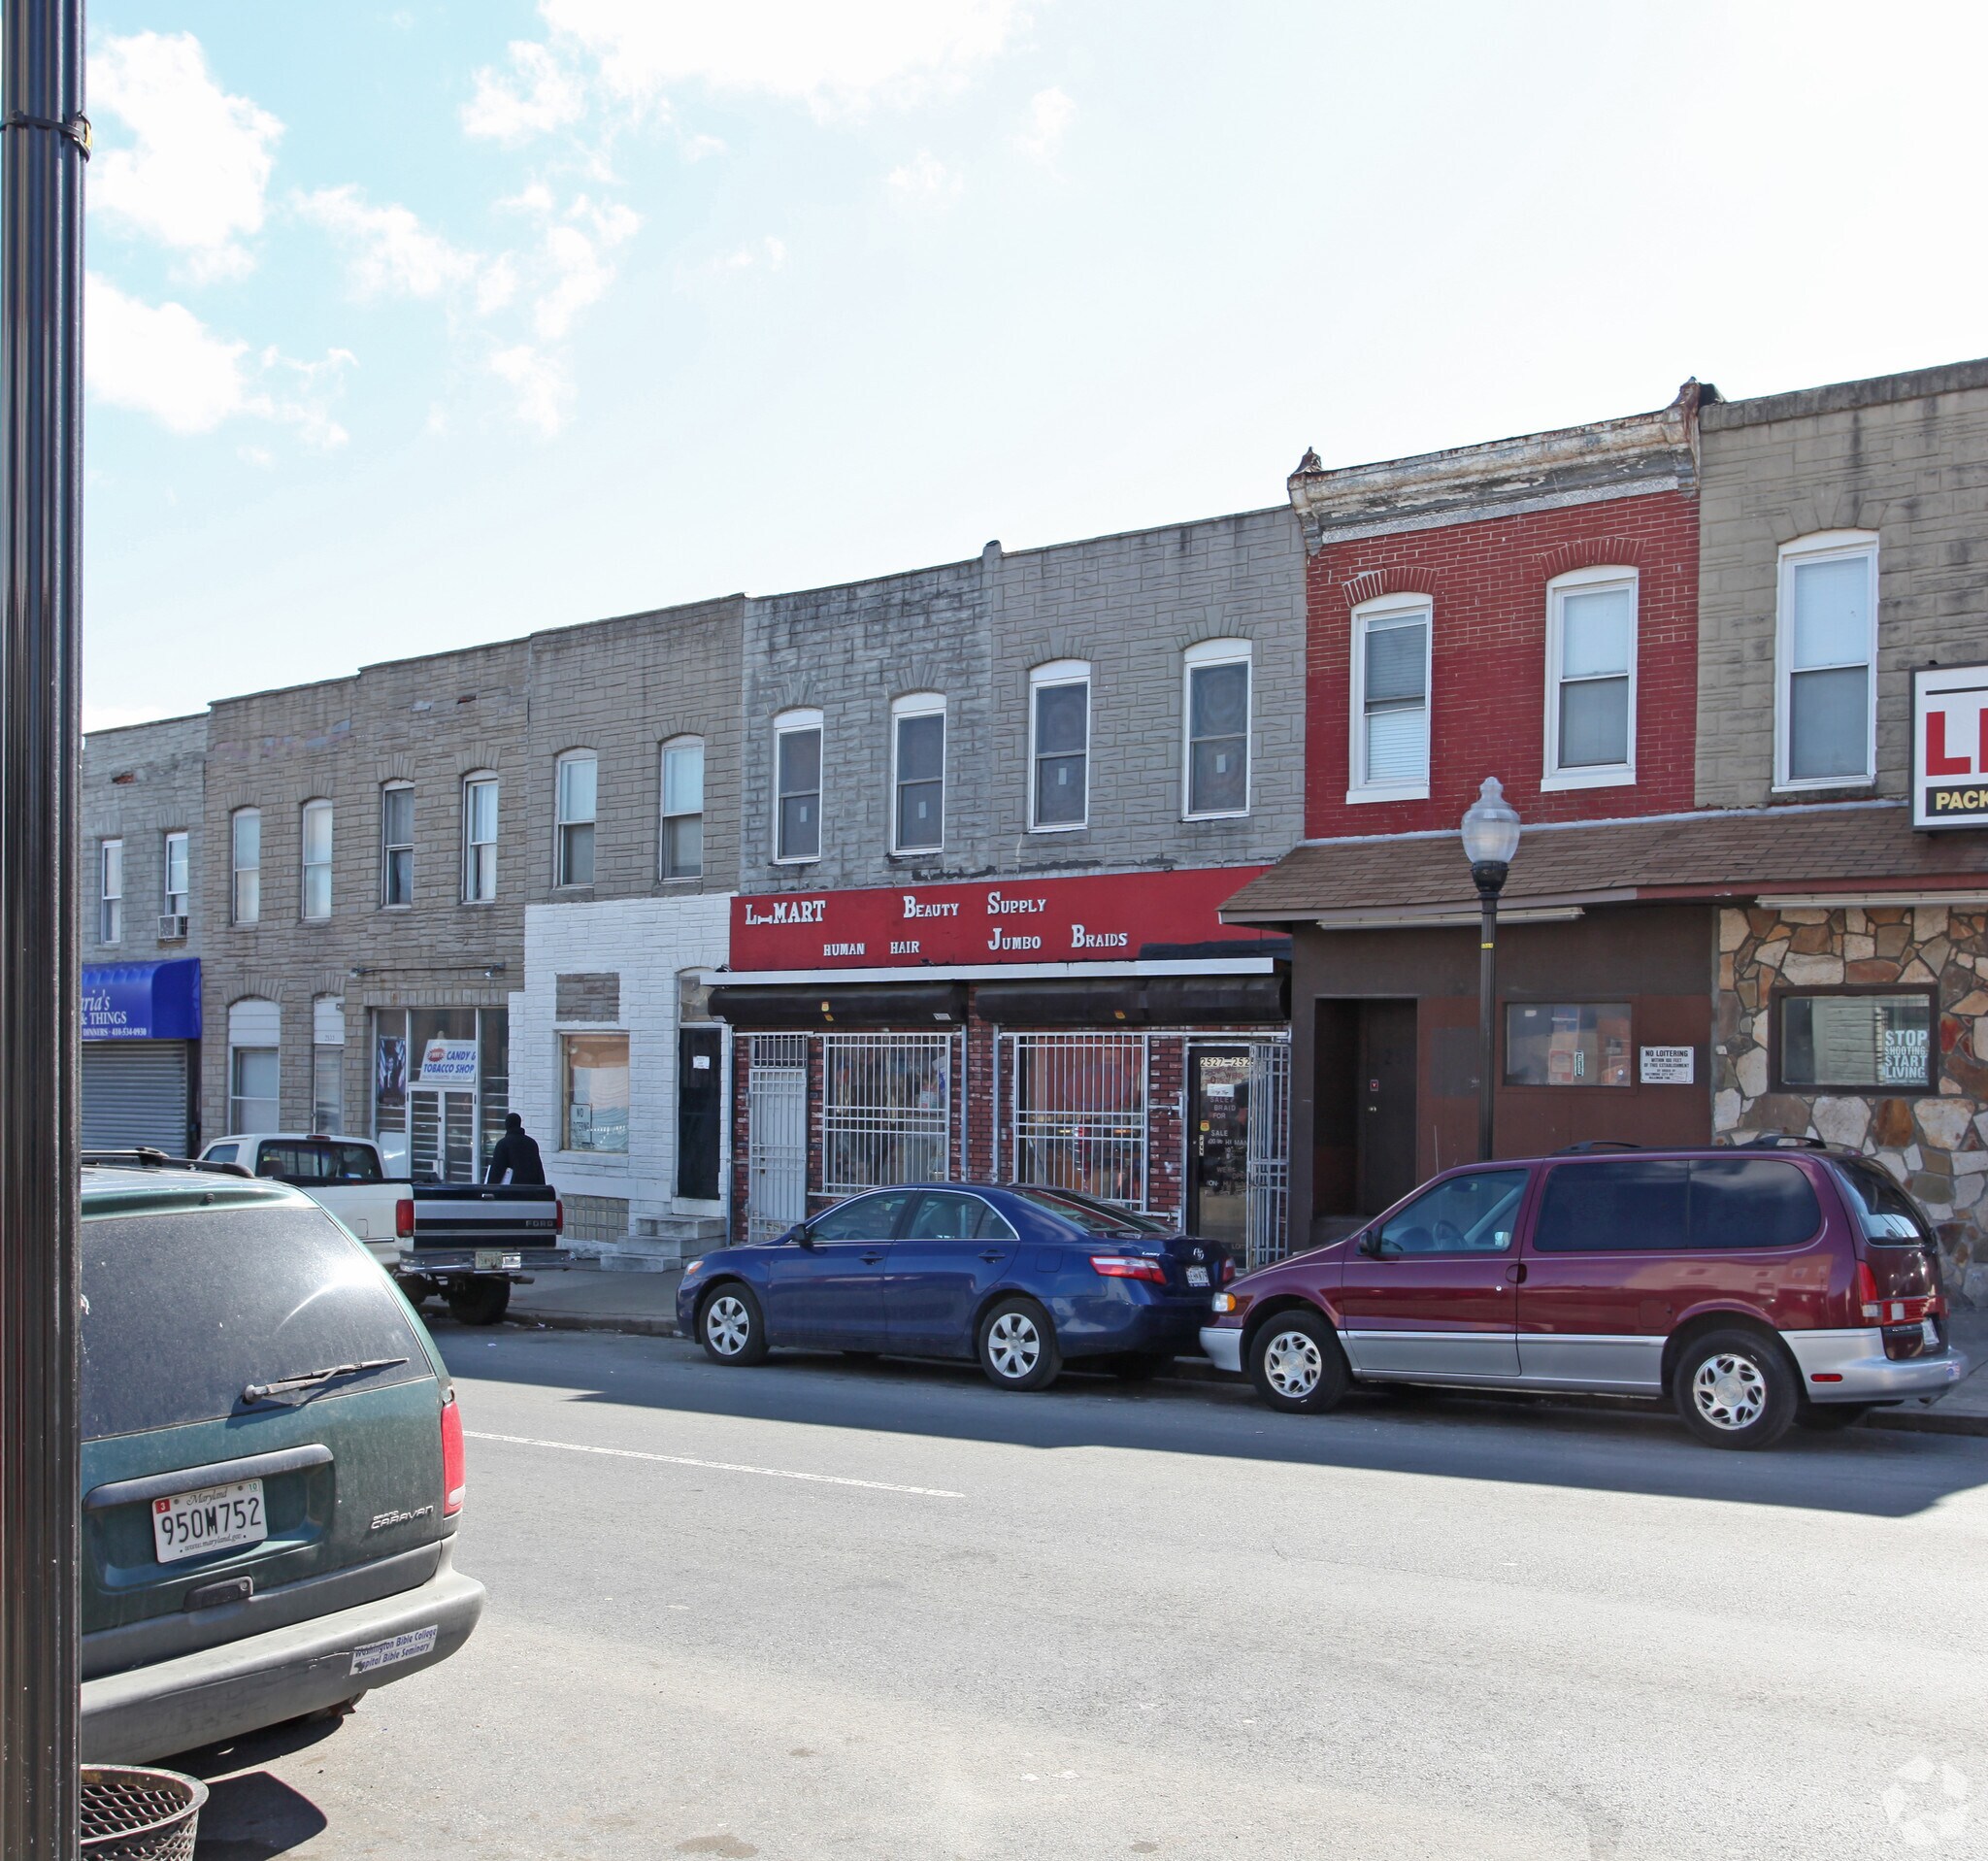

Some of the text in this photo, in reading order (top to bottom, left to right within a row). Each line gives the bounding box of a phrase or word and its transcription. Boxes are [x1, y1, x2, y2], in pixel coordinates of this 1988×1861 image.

[823, 943, 866, 956] HUMAN
[890, 941, 920, 954] HAIR
[89, 1012, 127, 1025] THINGS
[112, 1027, 147, 1036] 410-534-0930
[1885, 1030, 1928, 1047] STOP
[447, 1050, 471, 1061] CANDY
[1885, 1055, 1928, 1067] START
[423, 1063, 475, 1074] TOBACCO SHOP
[576, 1108, 584, 1117] NO
[248, 1482, 257, 1491] 10
[186, 1487, 227, 1506] Maryland
[160, 1502, 166, 1512] 3
[161, 1497, 261, 1545] 950M752
[371, 1505, 434, 1529] CARAVAN
[354, 1629, 437, 1658] Washington Bible College
[382, 1651, 400, 1663] Bible
[401, 1643, 430, 1657] Seminary
